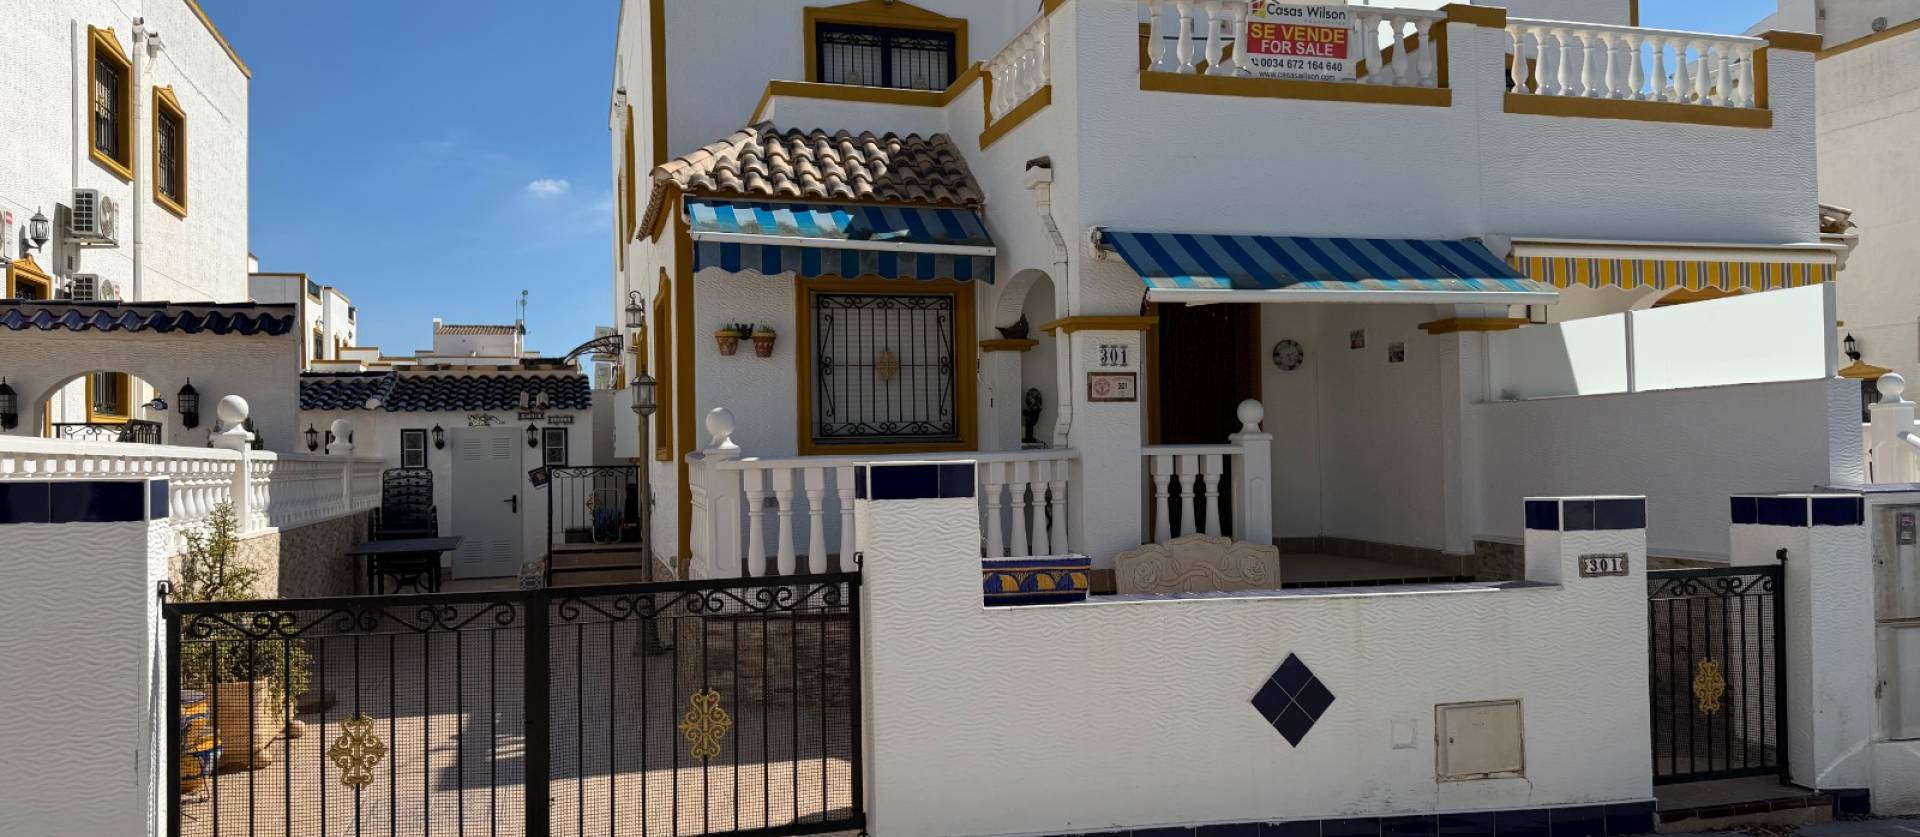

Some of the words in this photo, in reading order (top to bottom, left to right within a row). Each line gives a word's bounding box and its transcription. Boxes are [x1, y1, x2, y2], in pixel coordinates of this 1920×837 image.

[1267, 3, 1303, 17] Casas
[1307, 6, 1346, 20] Wilson
[1250, 23, 1276, 39] SE
[1281, 25, 1345, 44] VENDE
[1261, 40, 1292, 54] FOR
[1296, 42, 1334, 56] SALE
[1260, 58, 1284, 68] 0034
[1287, 60, 1304, 70] 672
[1307, 61, 1324, 71] 164
[1326, 62, 1343, 72] 640
[1100, 348, 1127, 365] 301
[1590, 558, 1617, 572] 301
